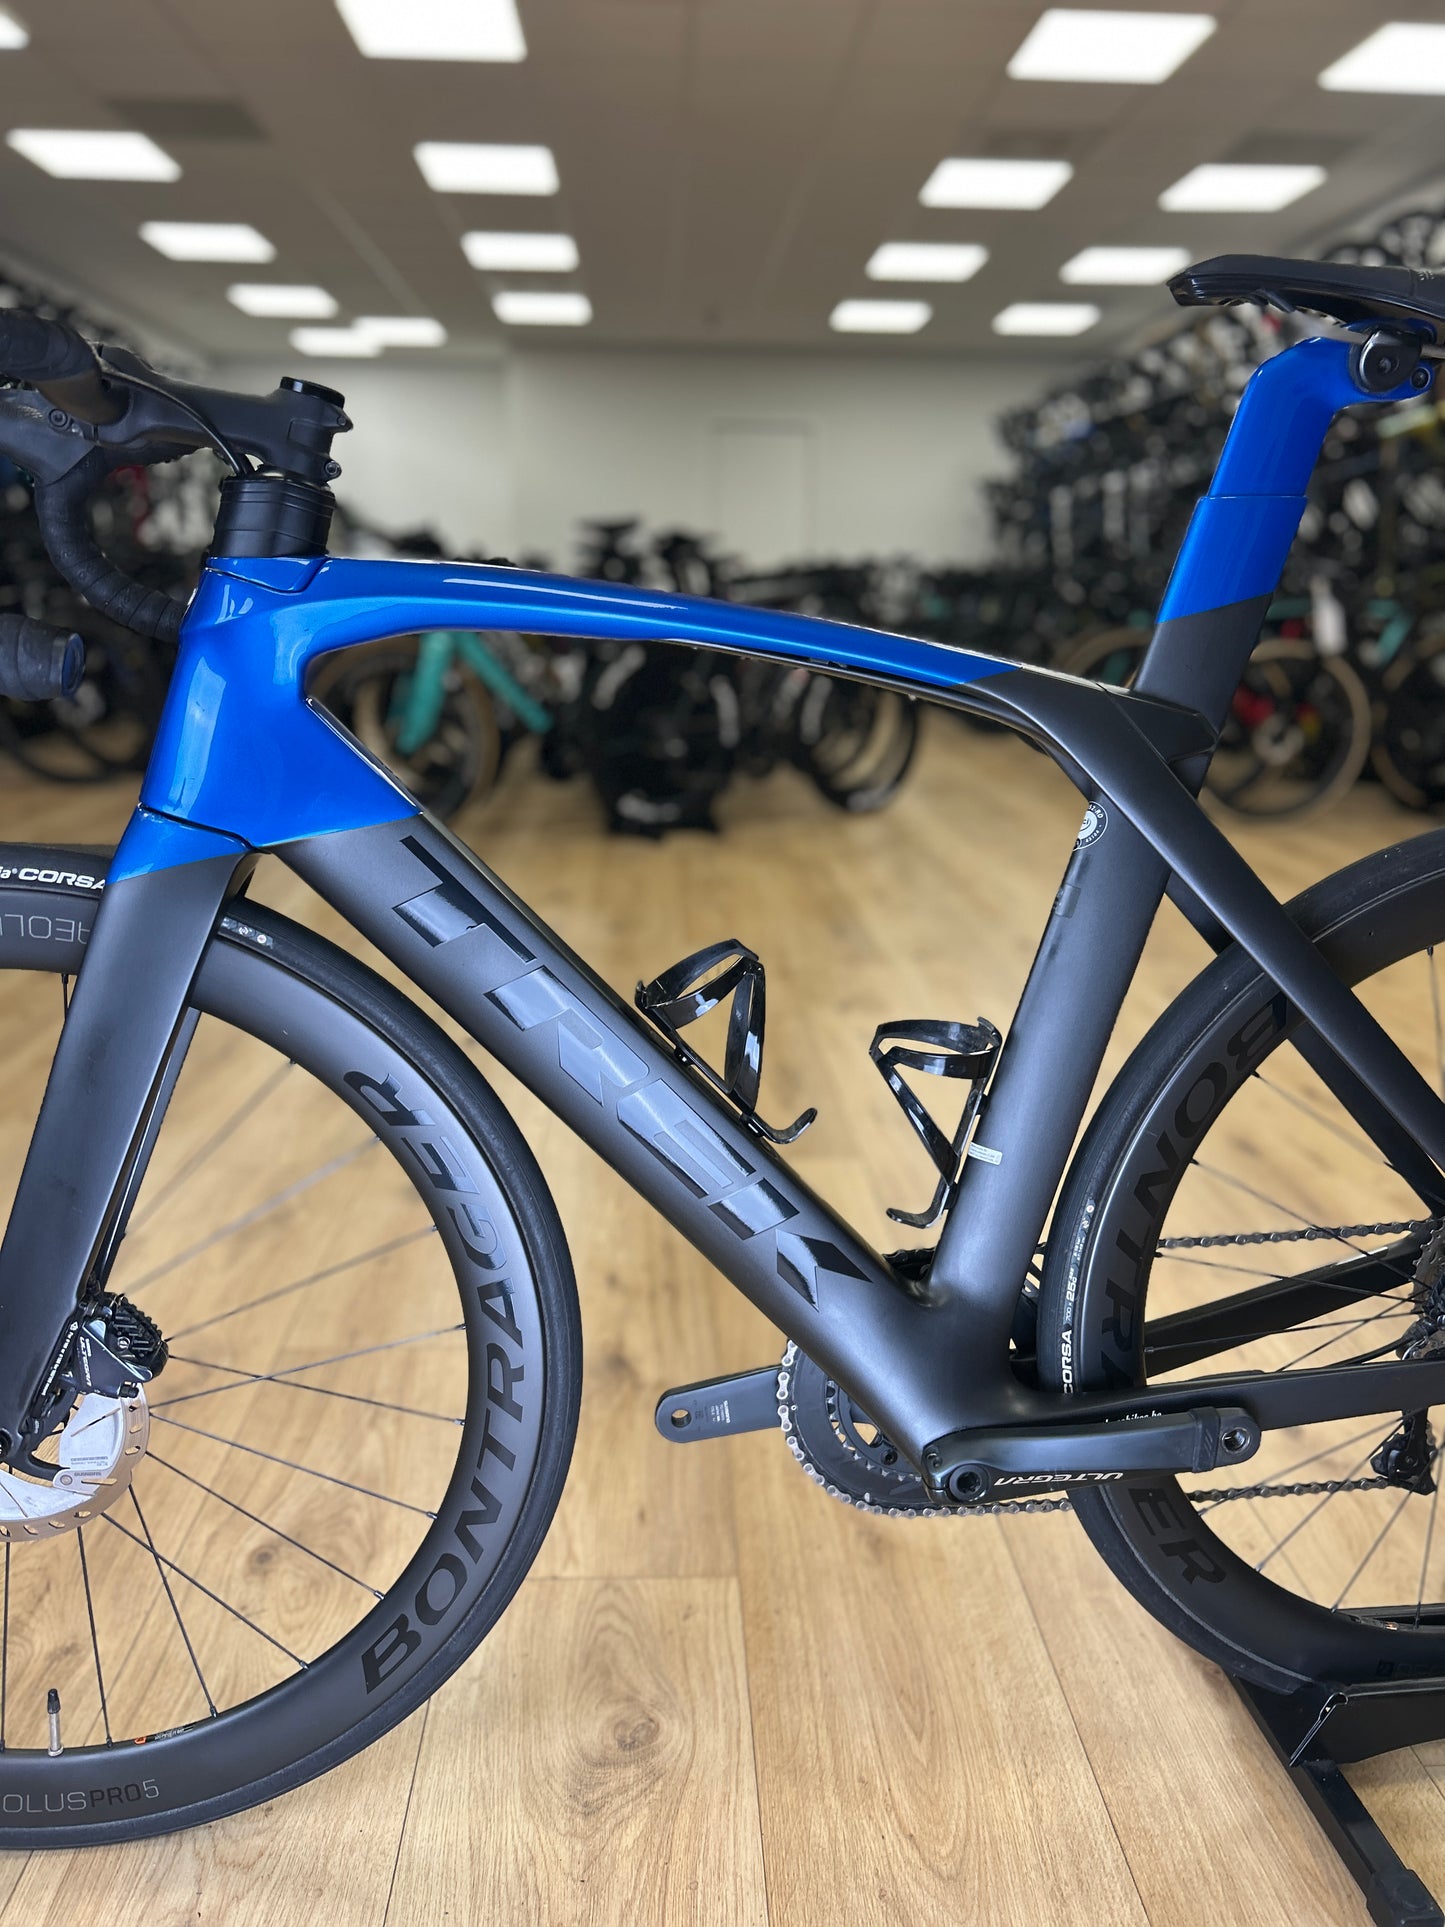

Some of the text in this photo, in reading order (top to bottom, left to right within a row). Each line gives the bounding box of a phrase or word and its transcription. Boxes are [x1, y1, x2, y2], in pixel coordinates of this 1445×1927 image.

[18, 867, 106, 891] CORSA
[0, 912, 91, 945] AEOL
[392, 834, 874, 1312] TREK
[342, 1070, 525, 1695] BONTRAGER
[993, 1471, 1124, 1487] ULTEGRA
